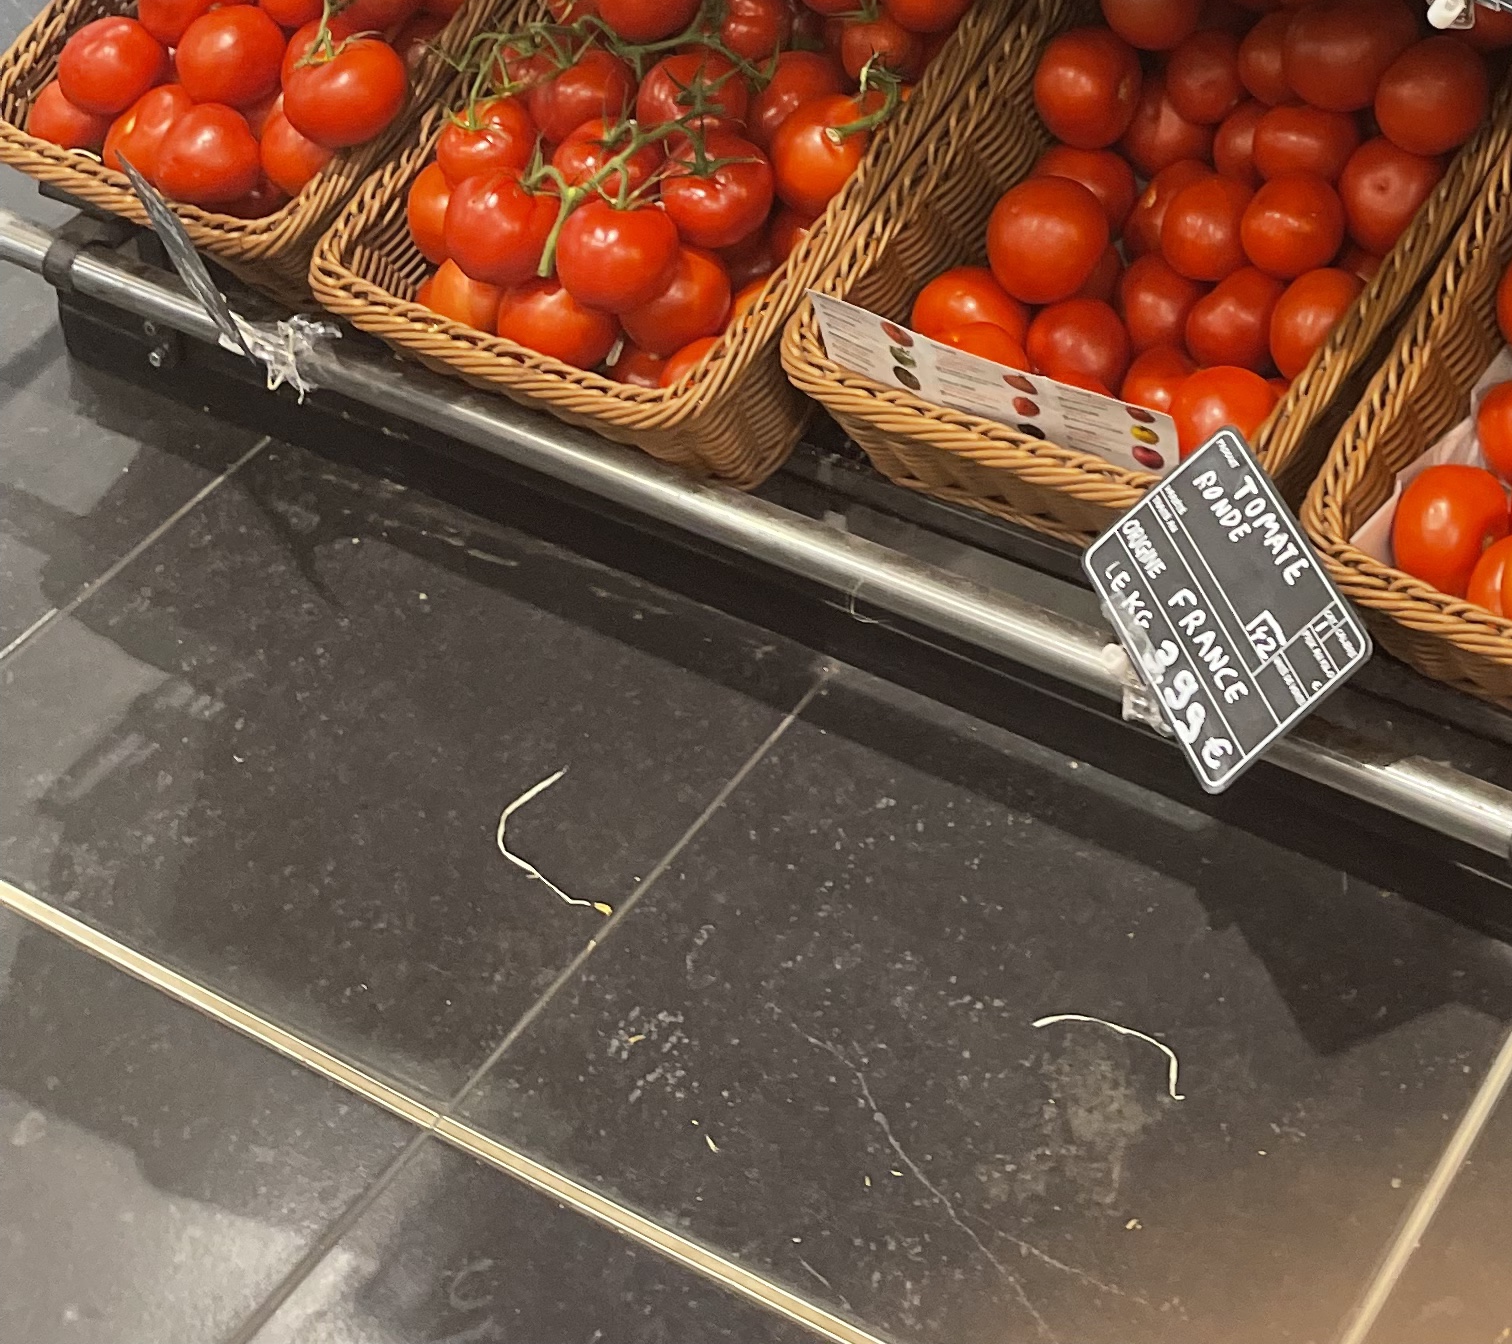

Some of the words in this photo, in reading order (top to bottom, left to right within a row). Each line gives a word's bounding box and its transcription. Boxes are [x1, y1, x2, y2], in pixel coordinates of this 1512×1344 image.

[1121, 518, 1168, 580] ORIGINE
[1192, 470, 1252, 544] RONDE
[1234, 474, 1310, 586] TOMATE
[1104, 560, 1131, 592] LE
[1121, 588, 1154, 629] KG
[1200, 735, 1234, 771] €
[1167, 588, 1249, 705] FRANCE
